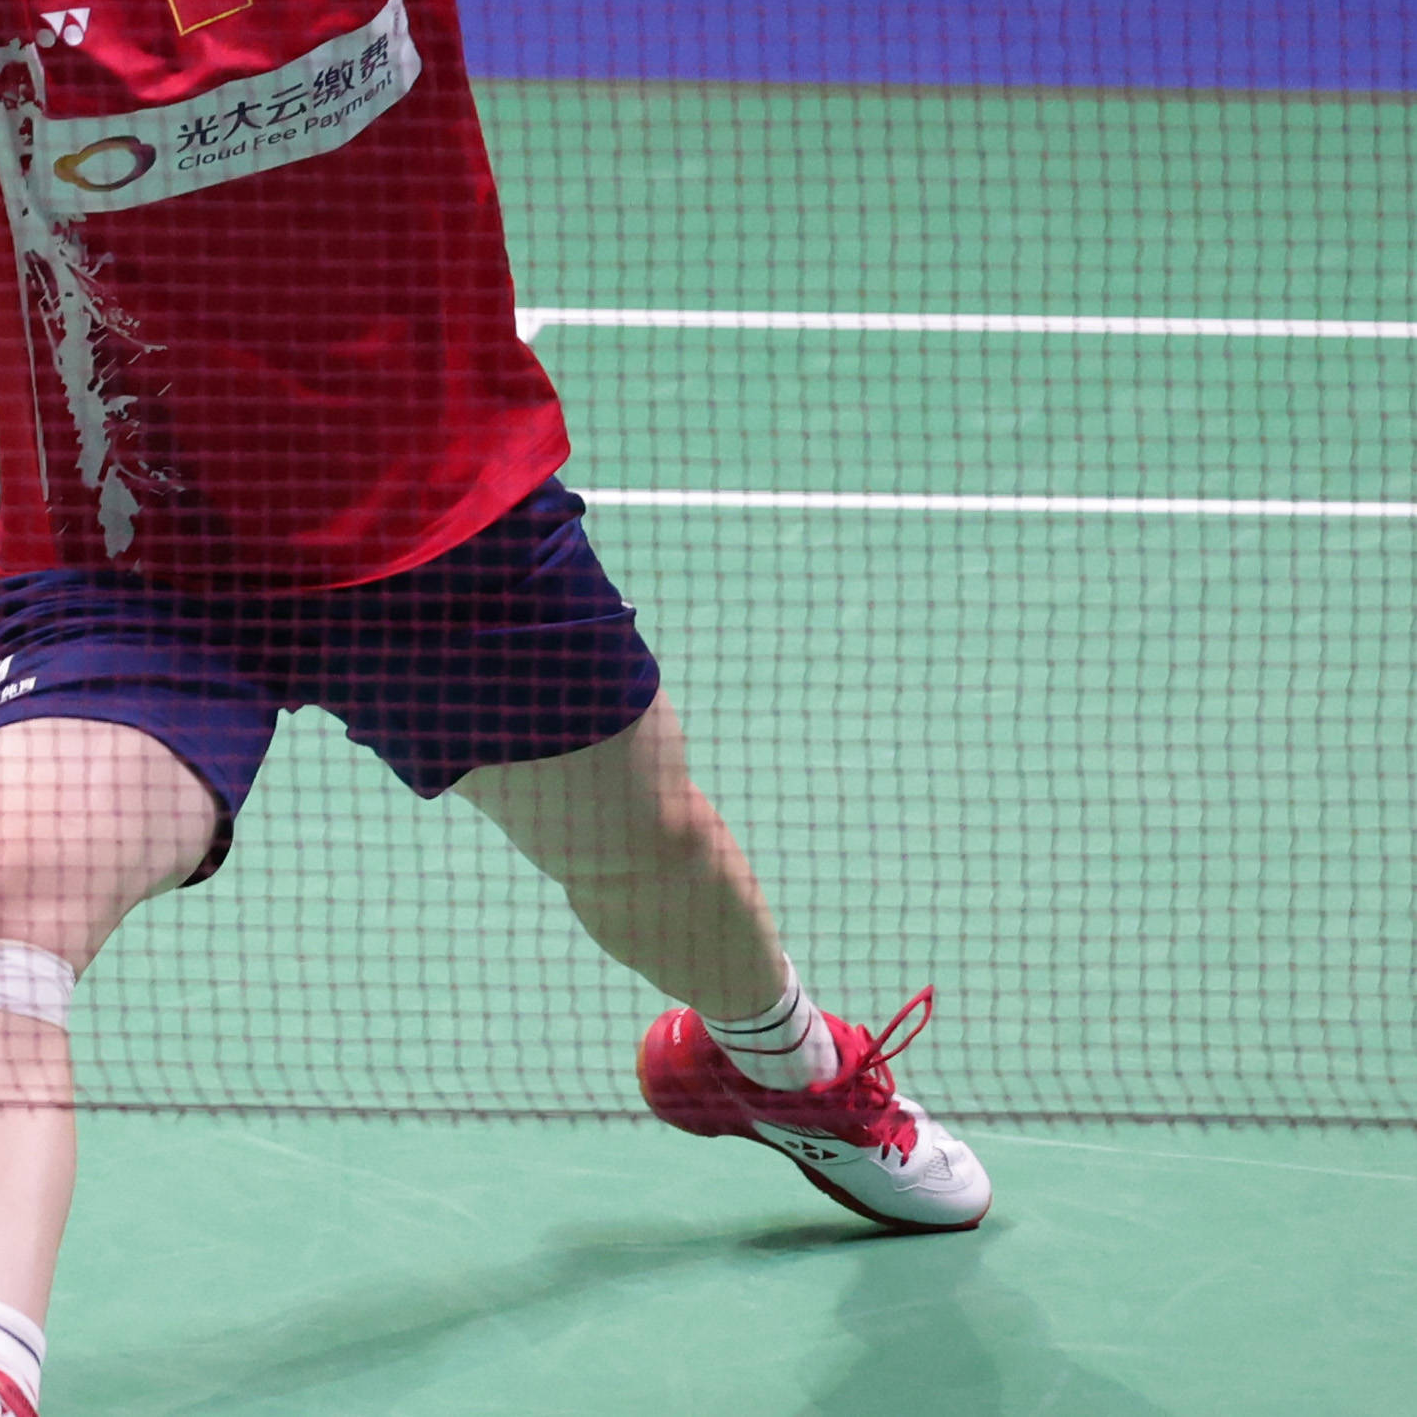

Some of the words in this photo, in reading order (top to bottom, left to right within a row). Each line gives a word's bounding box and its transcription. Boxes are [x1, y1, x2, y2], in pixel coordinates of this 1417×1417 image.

[175, 32, 390, 154] 光大云缴费
[177, 141, 246, 171] Cloud
[253, 127, 298, 151] Fee
[304, 70, 393, 134] Payment
